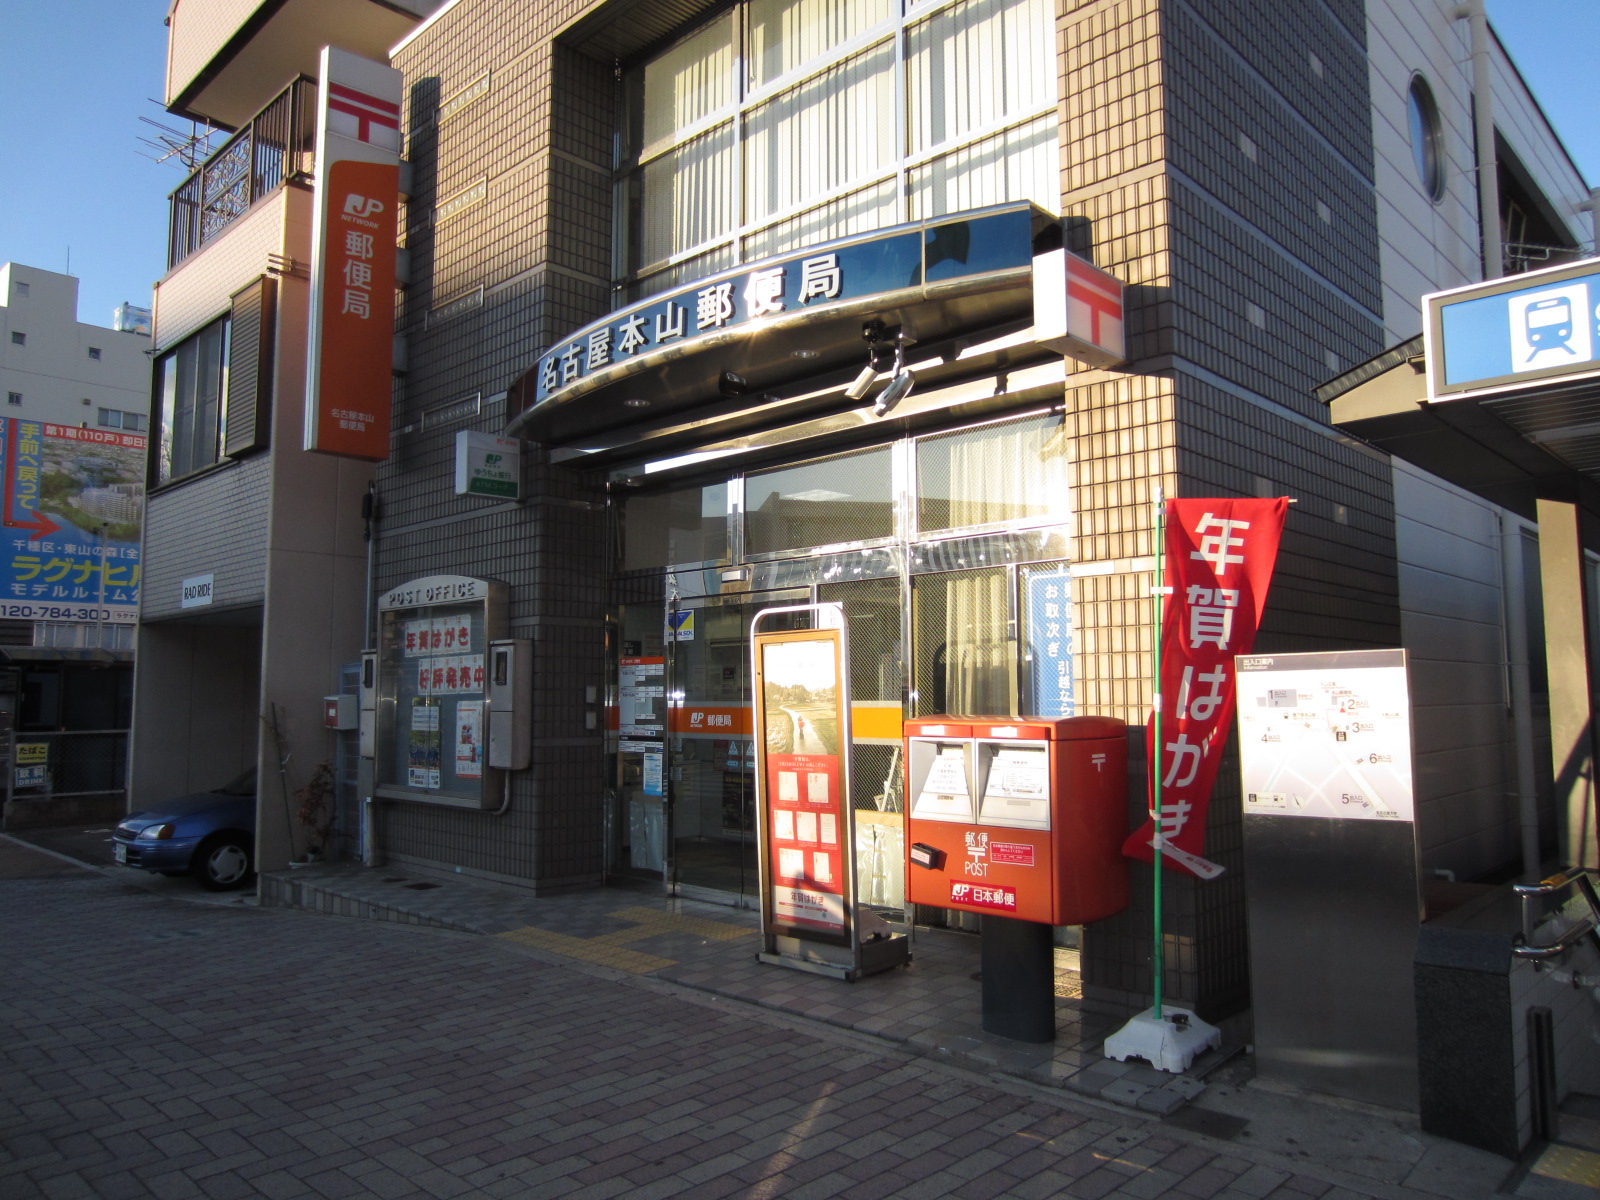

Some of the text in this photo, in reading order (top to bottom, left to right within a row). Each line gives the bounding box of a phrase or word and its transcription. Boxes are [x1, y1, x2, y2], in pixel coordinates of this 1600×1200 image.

[341, 213, 380, 230] NETWORK
[342, 230, 374, 320] 郵便局
[541, 253, 842, 393] 名古屋本山郵便局
[331, 408, 375, 424] 名古屋本山
[46, 425, 120, 444] 第1期(110戸)
[339, 419, 366, 433] 郵便局
[17, 422, 40, 510] 手前へ戻って
[184, 582, 211, 600] RAD RIDE
[389, 581, 476, 606] POST OFFICE
[1045, 583, 1060, 658] お取次ぎ
[405, 626, 469, 651] 年賀はがき
[1243, 657, 1274, 666] 出入口案内
[419, 665, 485, 689] 好評発売中
[1158, 511, 1251, 843] 年賀はがき
[1058, 661, 1071, 717] 引越なら
[1268, 690, 1274, 699] 1
[1347, 699, 1356, 710] 2
[707, 714, 732, 727] 郵便局
[1352, 722, 1360, 734] 3
[1261, 733, 1268, 744] 4
[19, 746, 46, 755] たばこ
[1369, 753, 1377, 764] 6
[18, 777, 45, 785] DRINK
[19, 767, 44, 778] 飲料
[1341, 793, 1350, 804] 5
[965, 831, 989, 849] 郵便
[965, 861, 989, 878] POST
[790, 891, 825, 907] 年賀はがき
[973, 887, 1016, 907] 日本郵便
